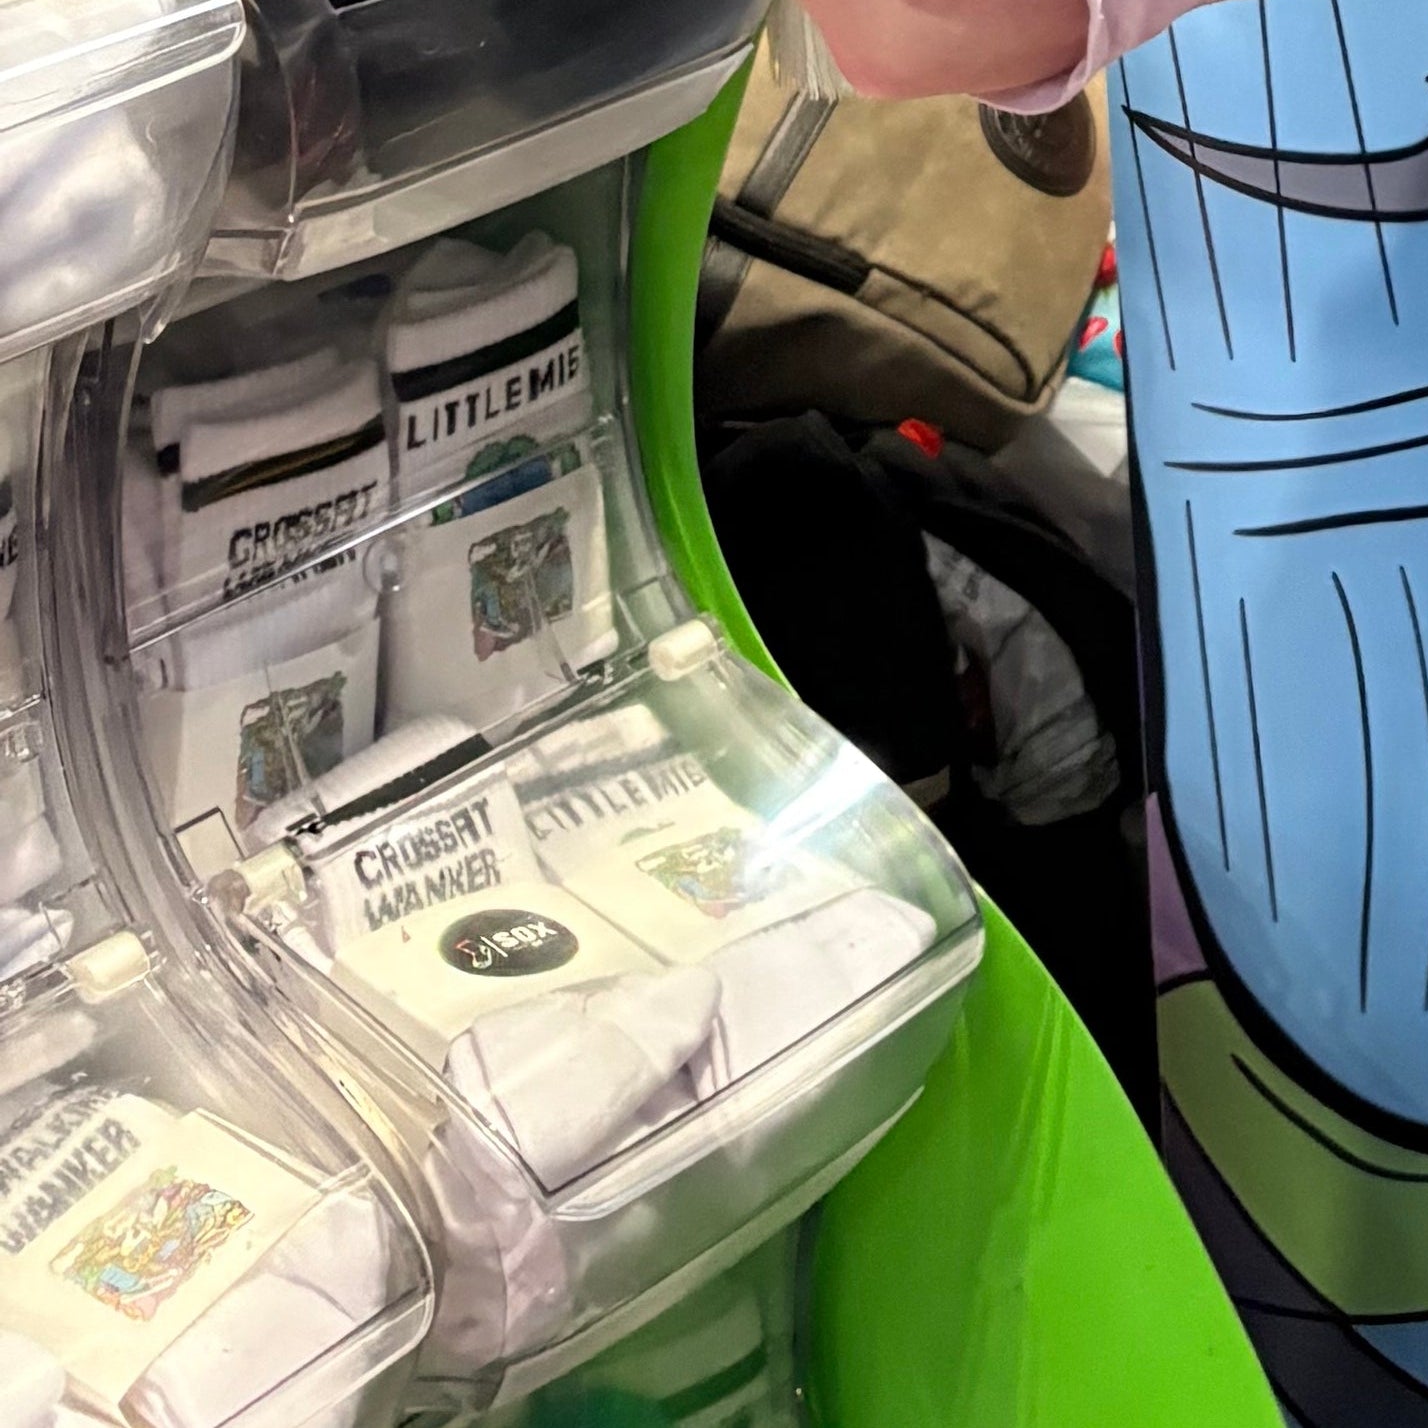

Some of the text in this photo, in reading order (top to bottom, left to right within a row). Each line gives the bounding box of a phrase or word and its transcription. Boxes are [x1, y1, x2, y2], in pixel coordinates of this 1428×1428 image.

[406, 375, 523, 450] LITTLE
[363, 846, 502, 933] WANKER
[491, 917, 558, 950] SOX
[0, 1117, 142, 1255] WANKER
